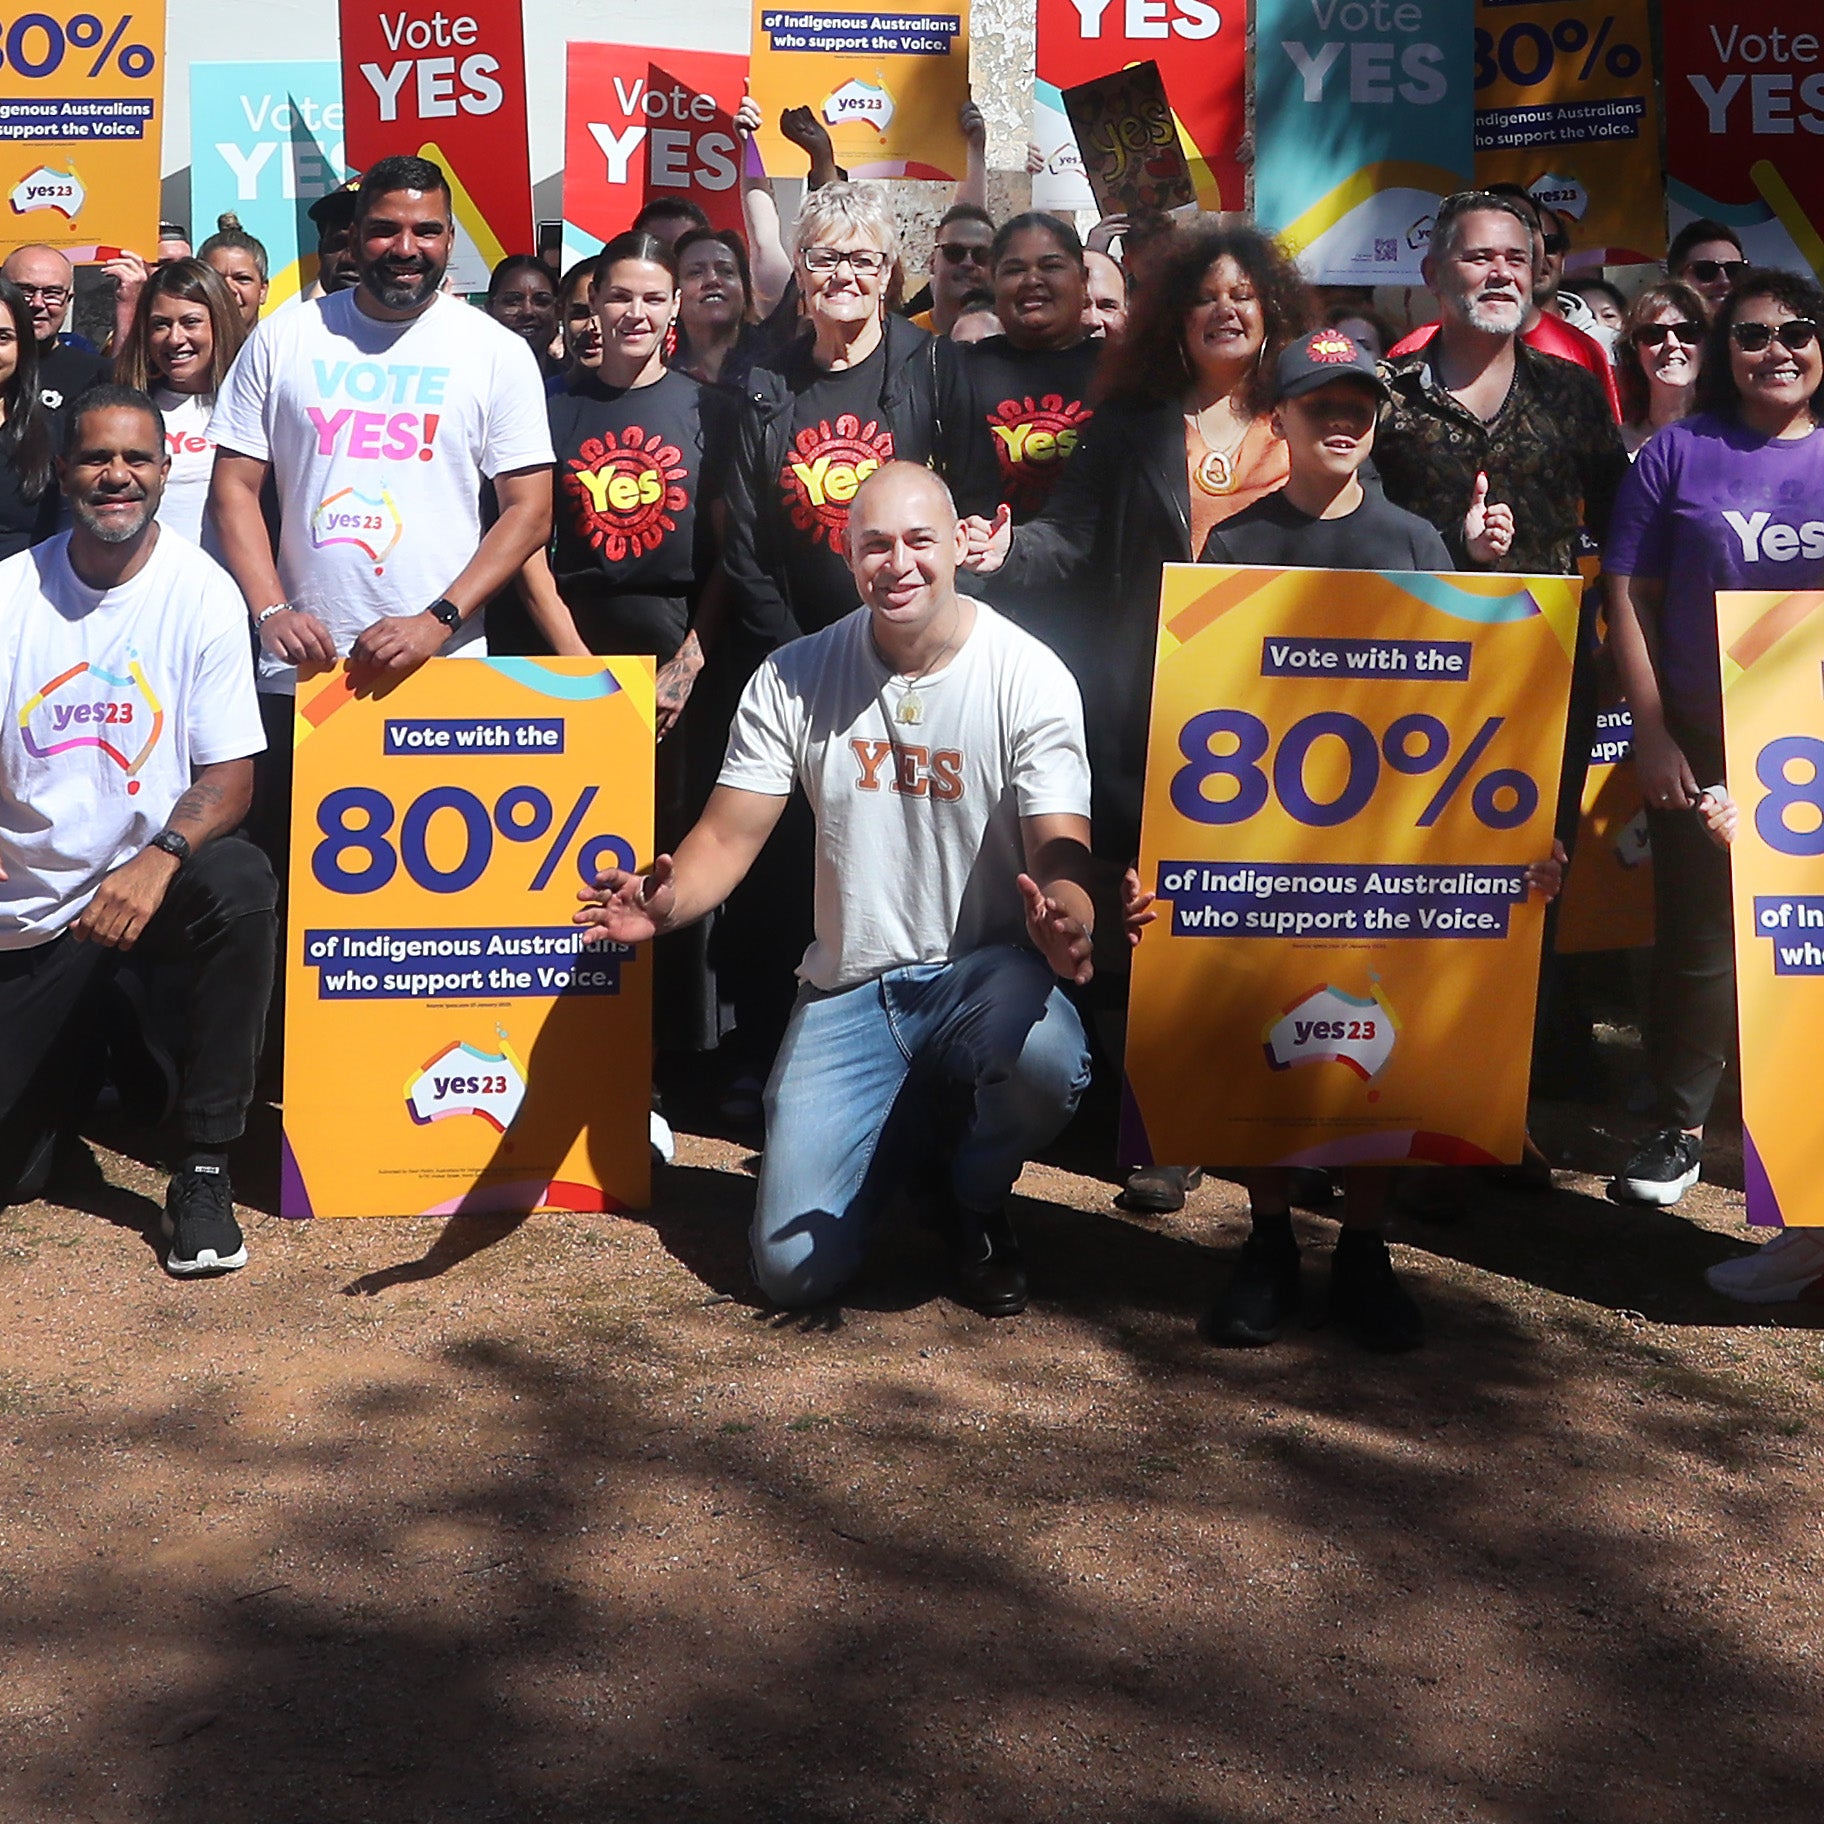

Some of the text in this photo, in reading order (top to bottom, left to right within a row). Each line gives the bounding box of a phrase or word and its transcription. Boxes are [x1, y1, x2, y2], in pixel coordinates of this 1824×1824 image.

[380, 12, 477, 50] Vote
[764, 11, 957, 32] of Indigenous Australians
[773, 33, 948, 51] who support the Voice.
[1710, 25, 1819, 62] Vote
[360, 54, 502, 121] YES
[1280, 41, 1449, 106] YES
[60, 102, 151, 116] Australians
[240, 93, 343, 133] Vote
[613, 77, 717, 123] Vote
[838, 98, 883, 112] yes23
[61, 122, 89, 136] the
[97, 121, 140, 136] Voice.
[1474, 103, 1642, 129] ndigenous Australians
[1090, 98, 1175, 183] yes
[1474, 121, 1634, 147] ho support the Voice.
[587, 121, 738, 192] YES
[312, 359, 451, 405] VOTE
[306, 407, 439, 462] YES!
[992, 422, 1079, 463] Yes
[577, 466, 663, 512] Yes
[326, 514, 382, 530] yes23
[1270, 645, 1463, 672] Vote with the
[53, 702, 132, 731] yes23
[390, 725, 559, 747] Vote with the
[851, 739, 965, 802] YES
[1170, 710, 1538, 829] 80%
[312, 785, 637, 895] 80%
[1164, 868, 1521, 898] of Indigenous Australians
[1180, 905, 1501, 934] who support the Voice.
[1760, 903, 1793, 928] of
[310, 936, 340, 958] of
[344, 936, 481, 962] Indigenous
[325, 967, 614, 995] who support the Voice.
[1293, 1021, 1375, 1046] yes23
[433, 1075, 507, 1100] yes23
